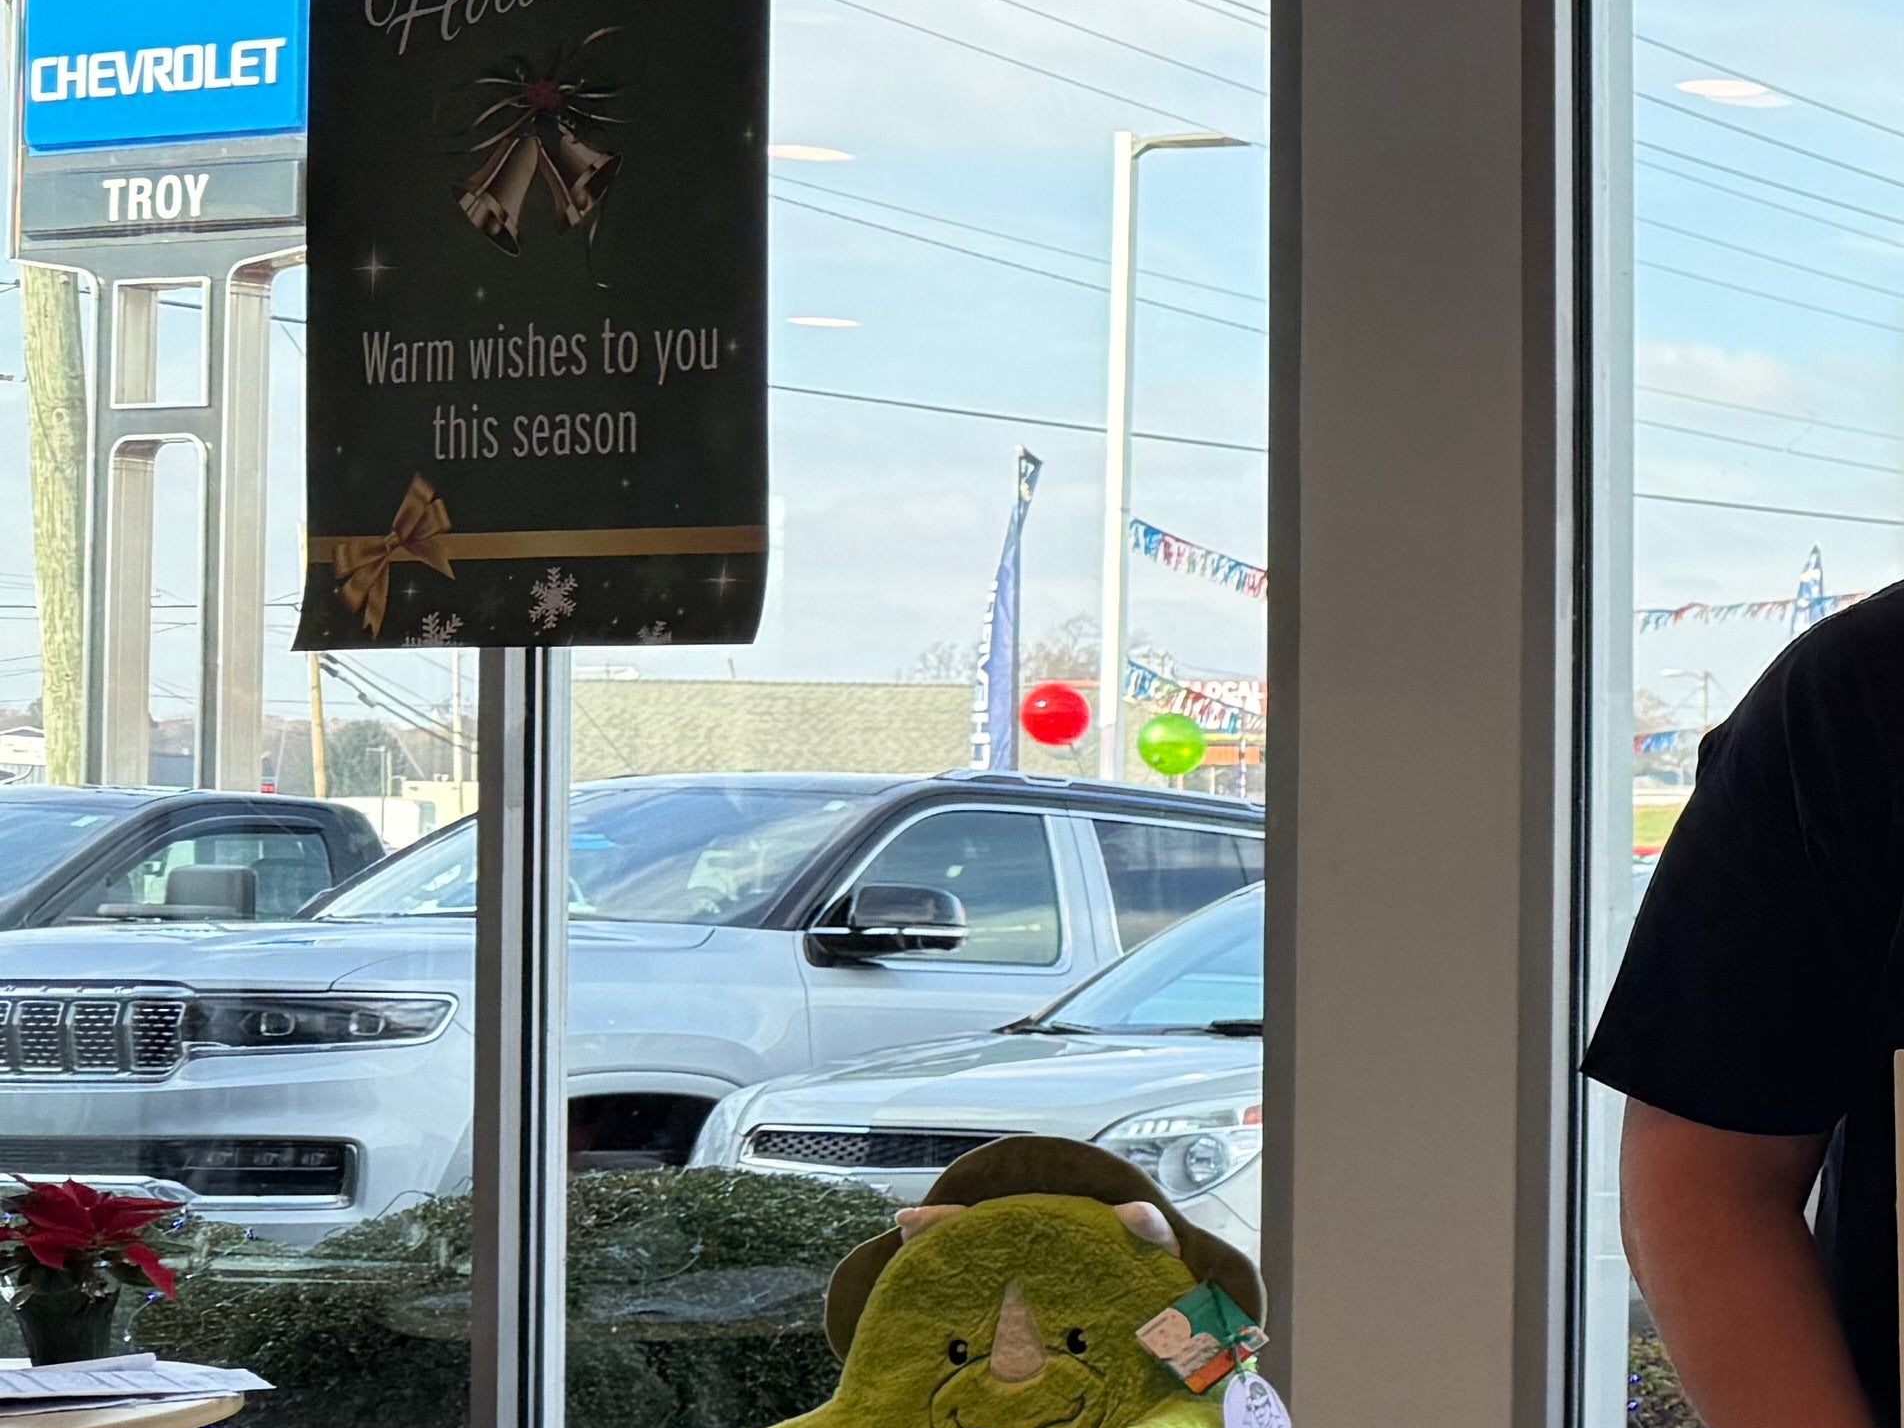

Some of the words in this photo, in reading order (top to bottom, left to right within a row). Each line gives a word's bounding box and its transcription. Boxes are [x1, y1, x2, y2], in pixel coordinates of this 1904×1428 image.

[30, 38, 286, 103] CHEVROLET
[103, 174, 209, 223] TROY
[362, 329, 455, 385] Warm
[468, 321, 588, 378] wishes
[601, 320, 636, 373] to
[653, 327, 720, 388] you
[433, 403, 500, 459] this
[512, 405, 637, 455] season
